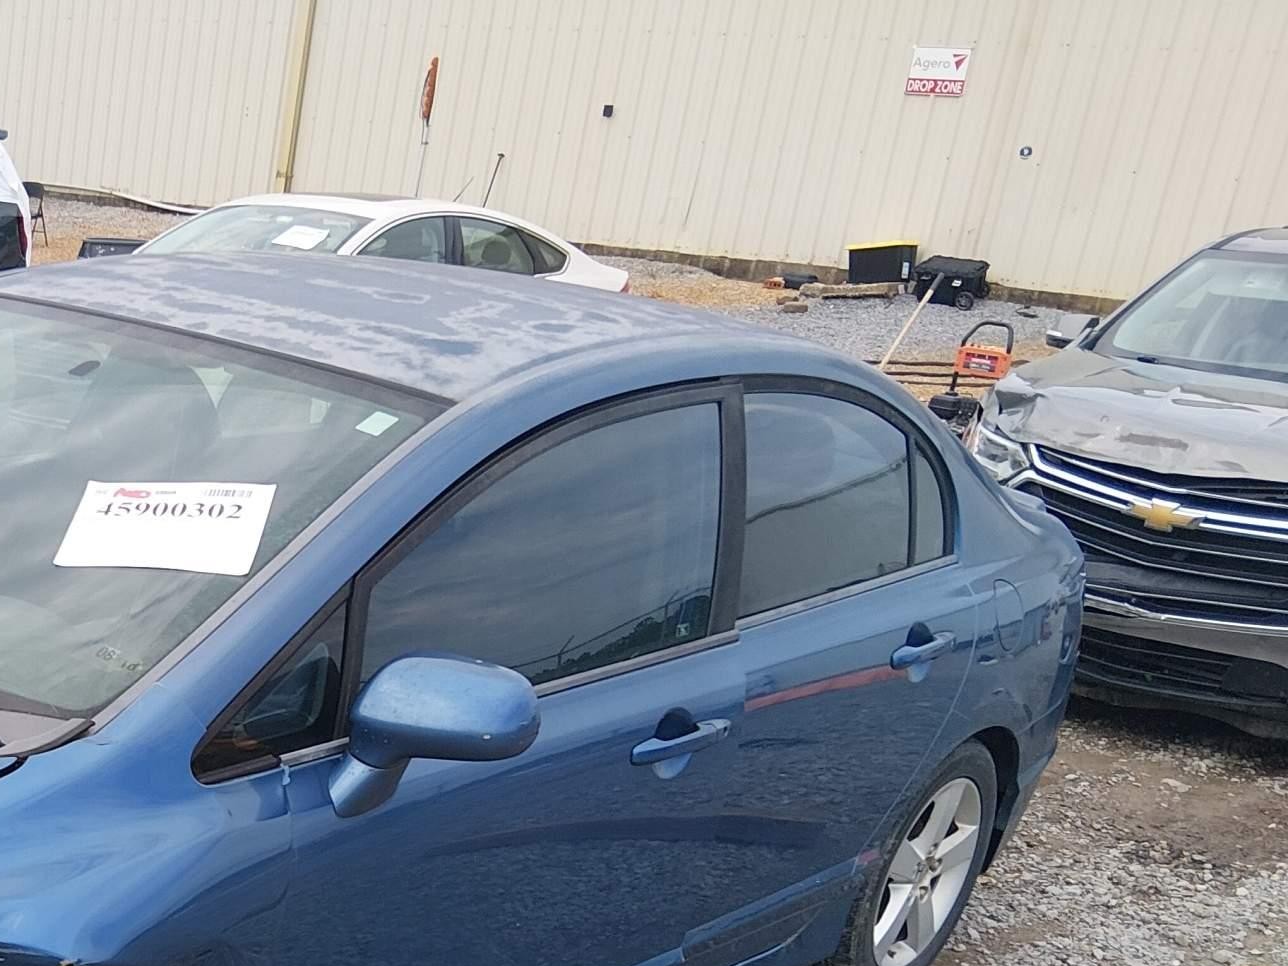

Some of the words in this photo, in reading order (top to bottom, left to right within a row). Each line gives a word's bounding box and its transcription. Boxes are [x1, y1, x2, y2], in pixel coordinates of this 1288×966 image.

[913, 57, 952, 72] Agero
[907, 79, 935, 93] DROP
[935, 80, 963, 94] ZONE
[96, 501, 244, 519] 45900302
